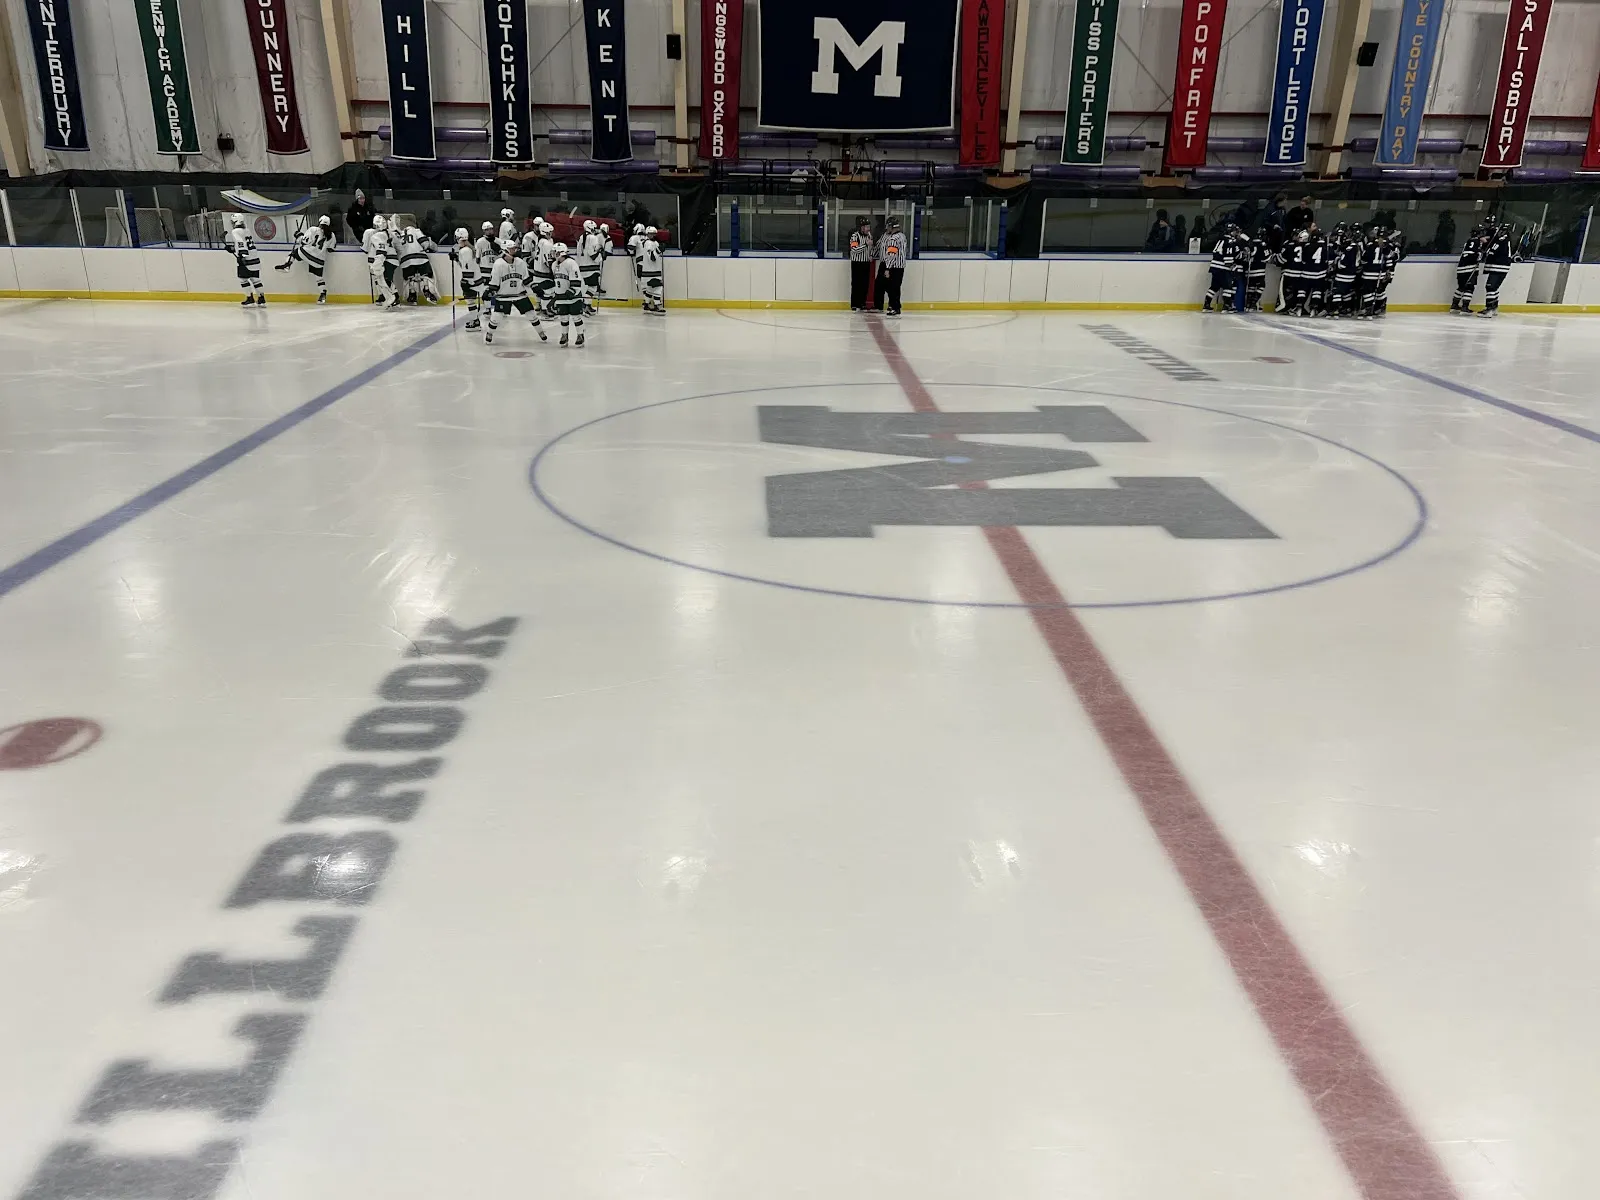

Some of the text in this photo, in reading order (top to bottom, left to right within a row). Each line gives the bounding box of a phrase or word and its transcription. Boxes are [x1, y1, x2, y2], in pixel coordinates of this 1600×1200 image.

[39, 0, 72, 146] NTERBURY
[149, 0, 182, 151] ENWICH ACADEMY
[396, 15, 417, 119] HILL
[497, 0, 519, 158] OTCHKISS
[597, 8, 617, 132] KENT
[712, 0, 727, 157] NGSWOOD OXFORD
[811, 17, 906, 98] M
[1184, 2, 1212, 149] POMFRET
[1278, 0, 1310, 160] ORTLEDGE
[1391, 0, 1430, 160] YE COUNTRY DAY
[1497, 0, 1538, 162] SALISBURY
[756, 404, 1283, 540] M
